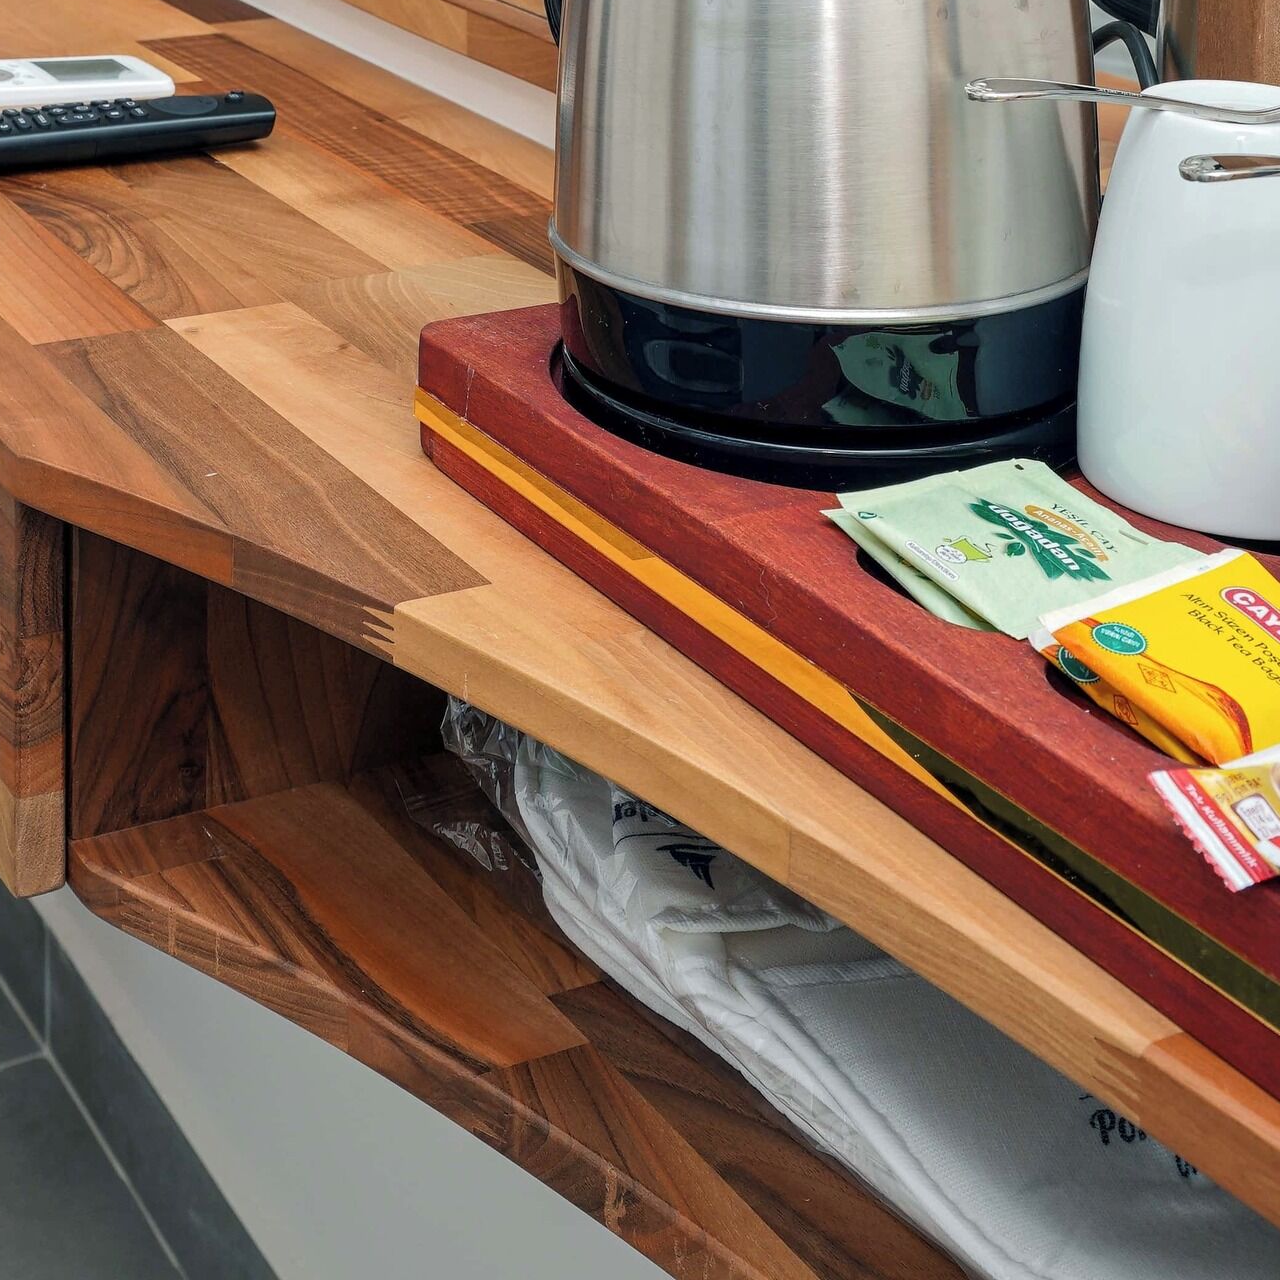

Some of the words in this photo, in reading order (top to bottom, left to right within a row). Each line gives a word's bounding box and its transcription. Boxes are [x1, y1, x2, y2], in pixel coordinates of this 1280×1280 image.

[1181, 592, 1214, 617] Altın
[1212, 608, 1256, 645] Süzen
[1186, 609, 1225, 636] Black
[1226, 637, 1253, 661] Tea
